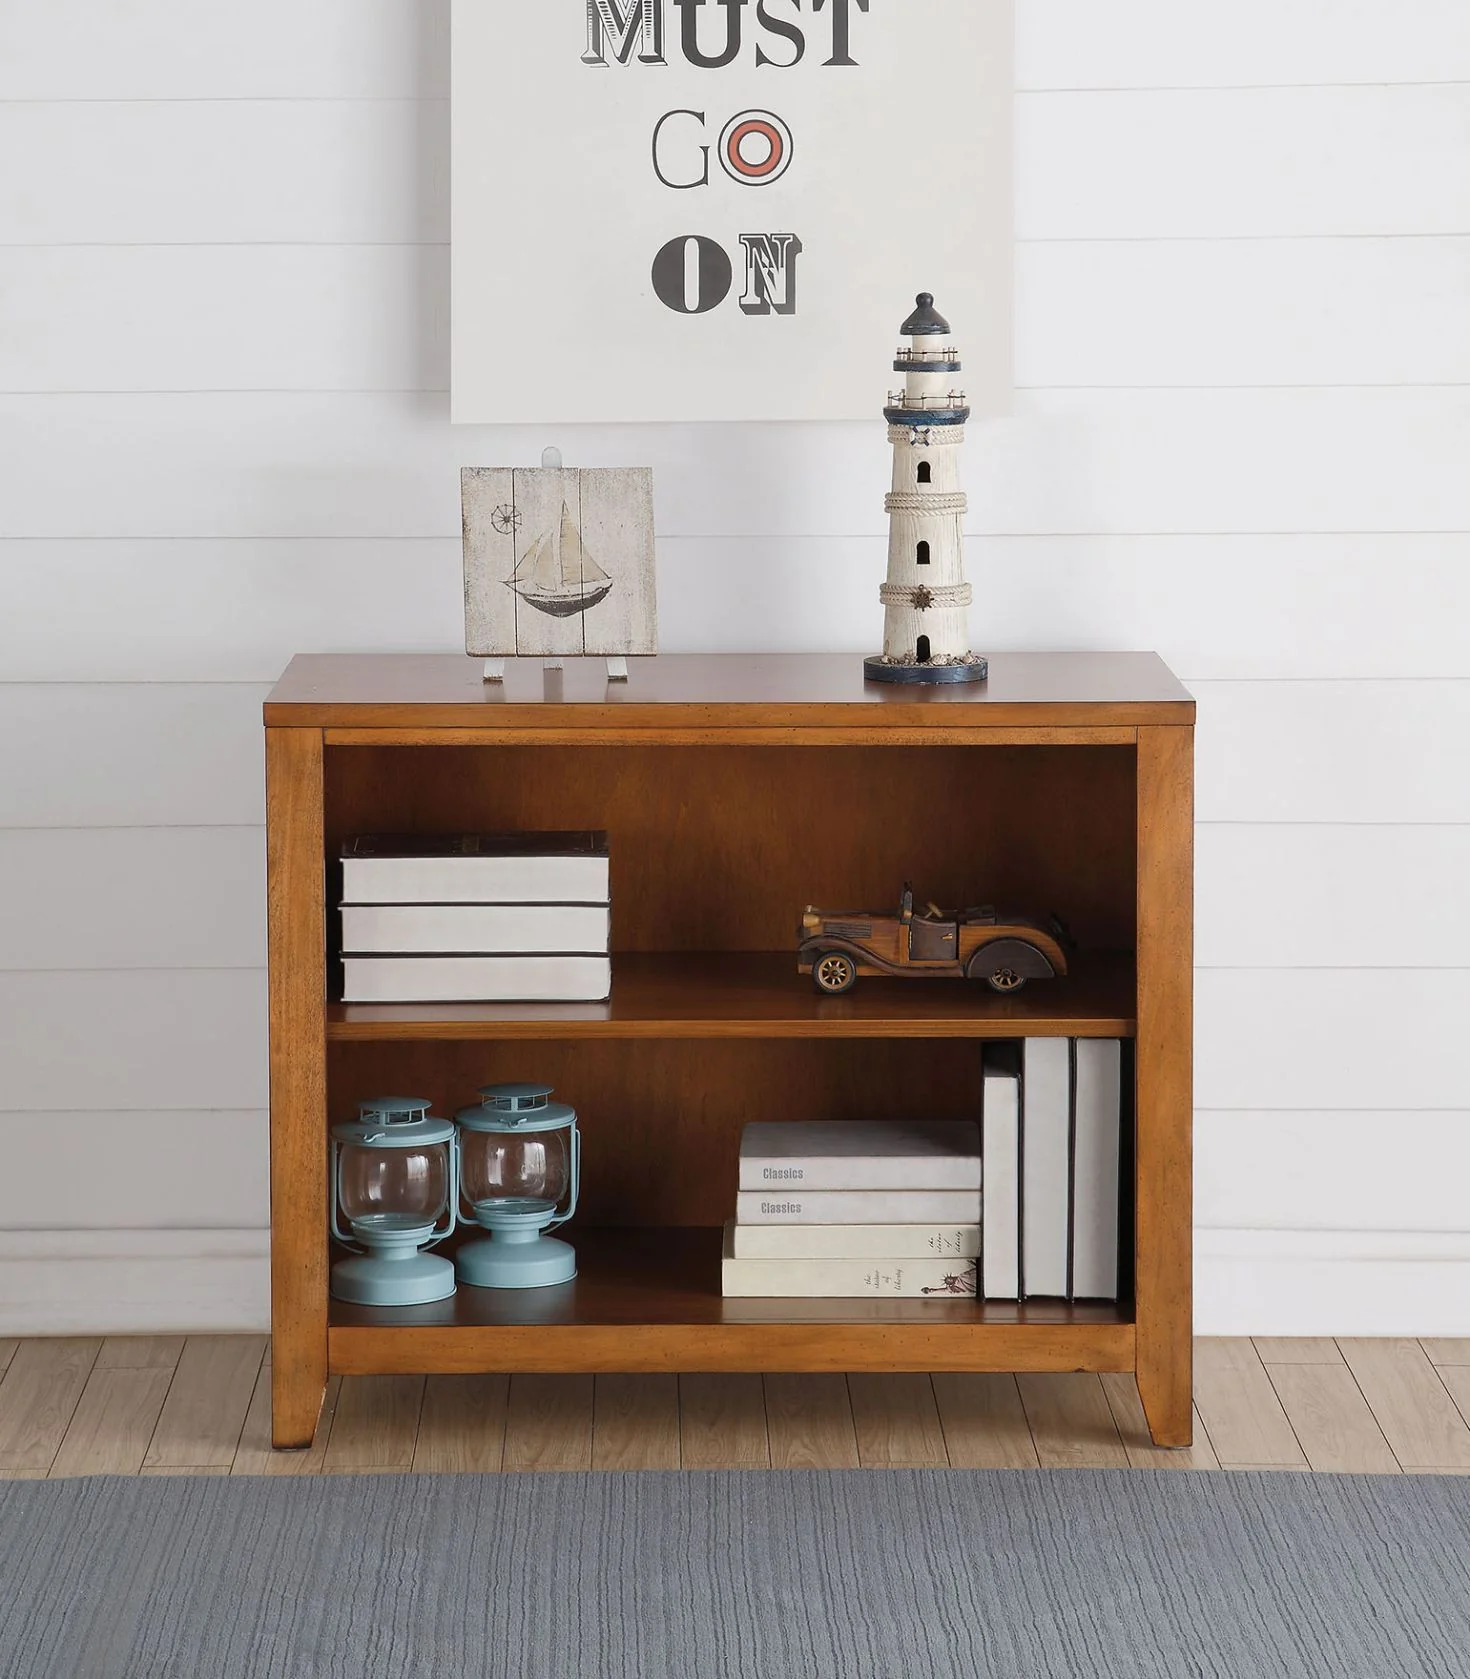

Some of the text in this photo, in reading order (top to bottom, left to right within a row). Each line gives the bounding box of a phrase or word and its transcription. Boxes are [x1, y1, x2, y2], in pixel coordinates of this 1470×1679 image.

[580, 0, 869, 68] MUST
[652, 109, 794, 190] GO
[651, 233, 803, 315] ON
[761, 1202, 802, 1214] Classics
[763, 1168, 804, 1180] Classics
